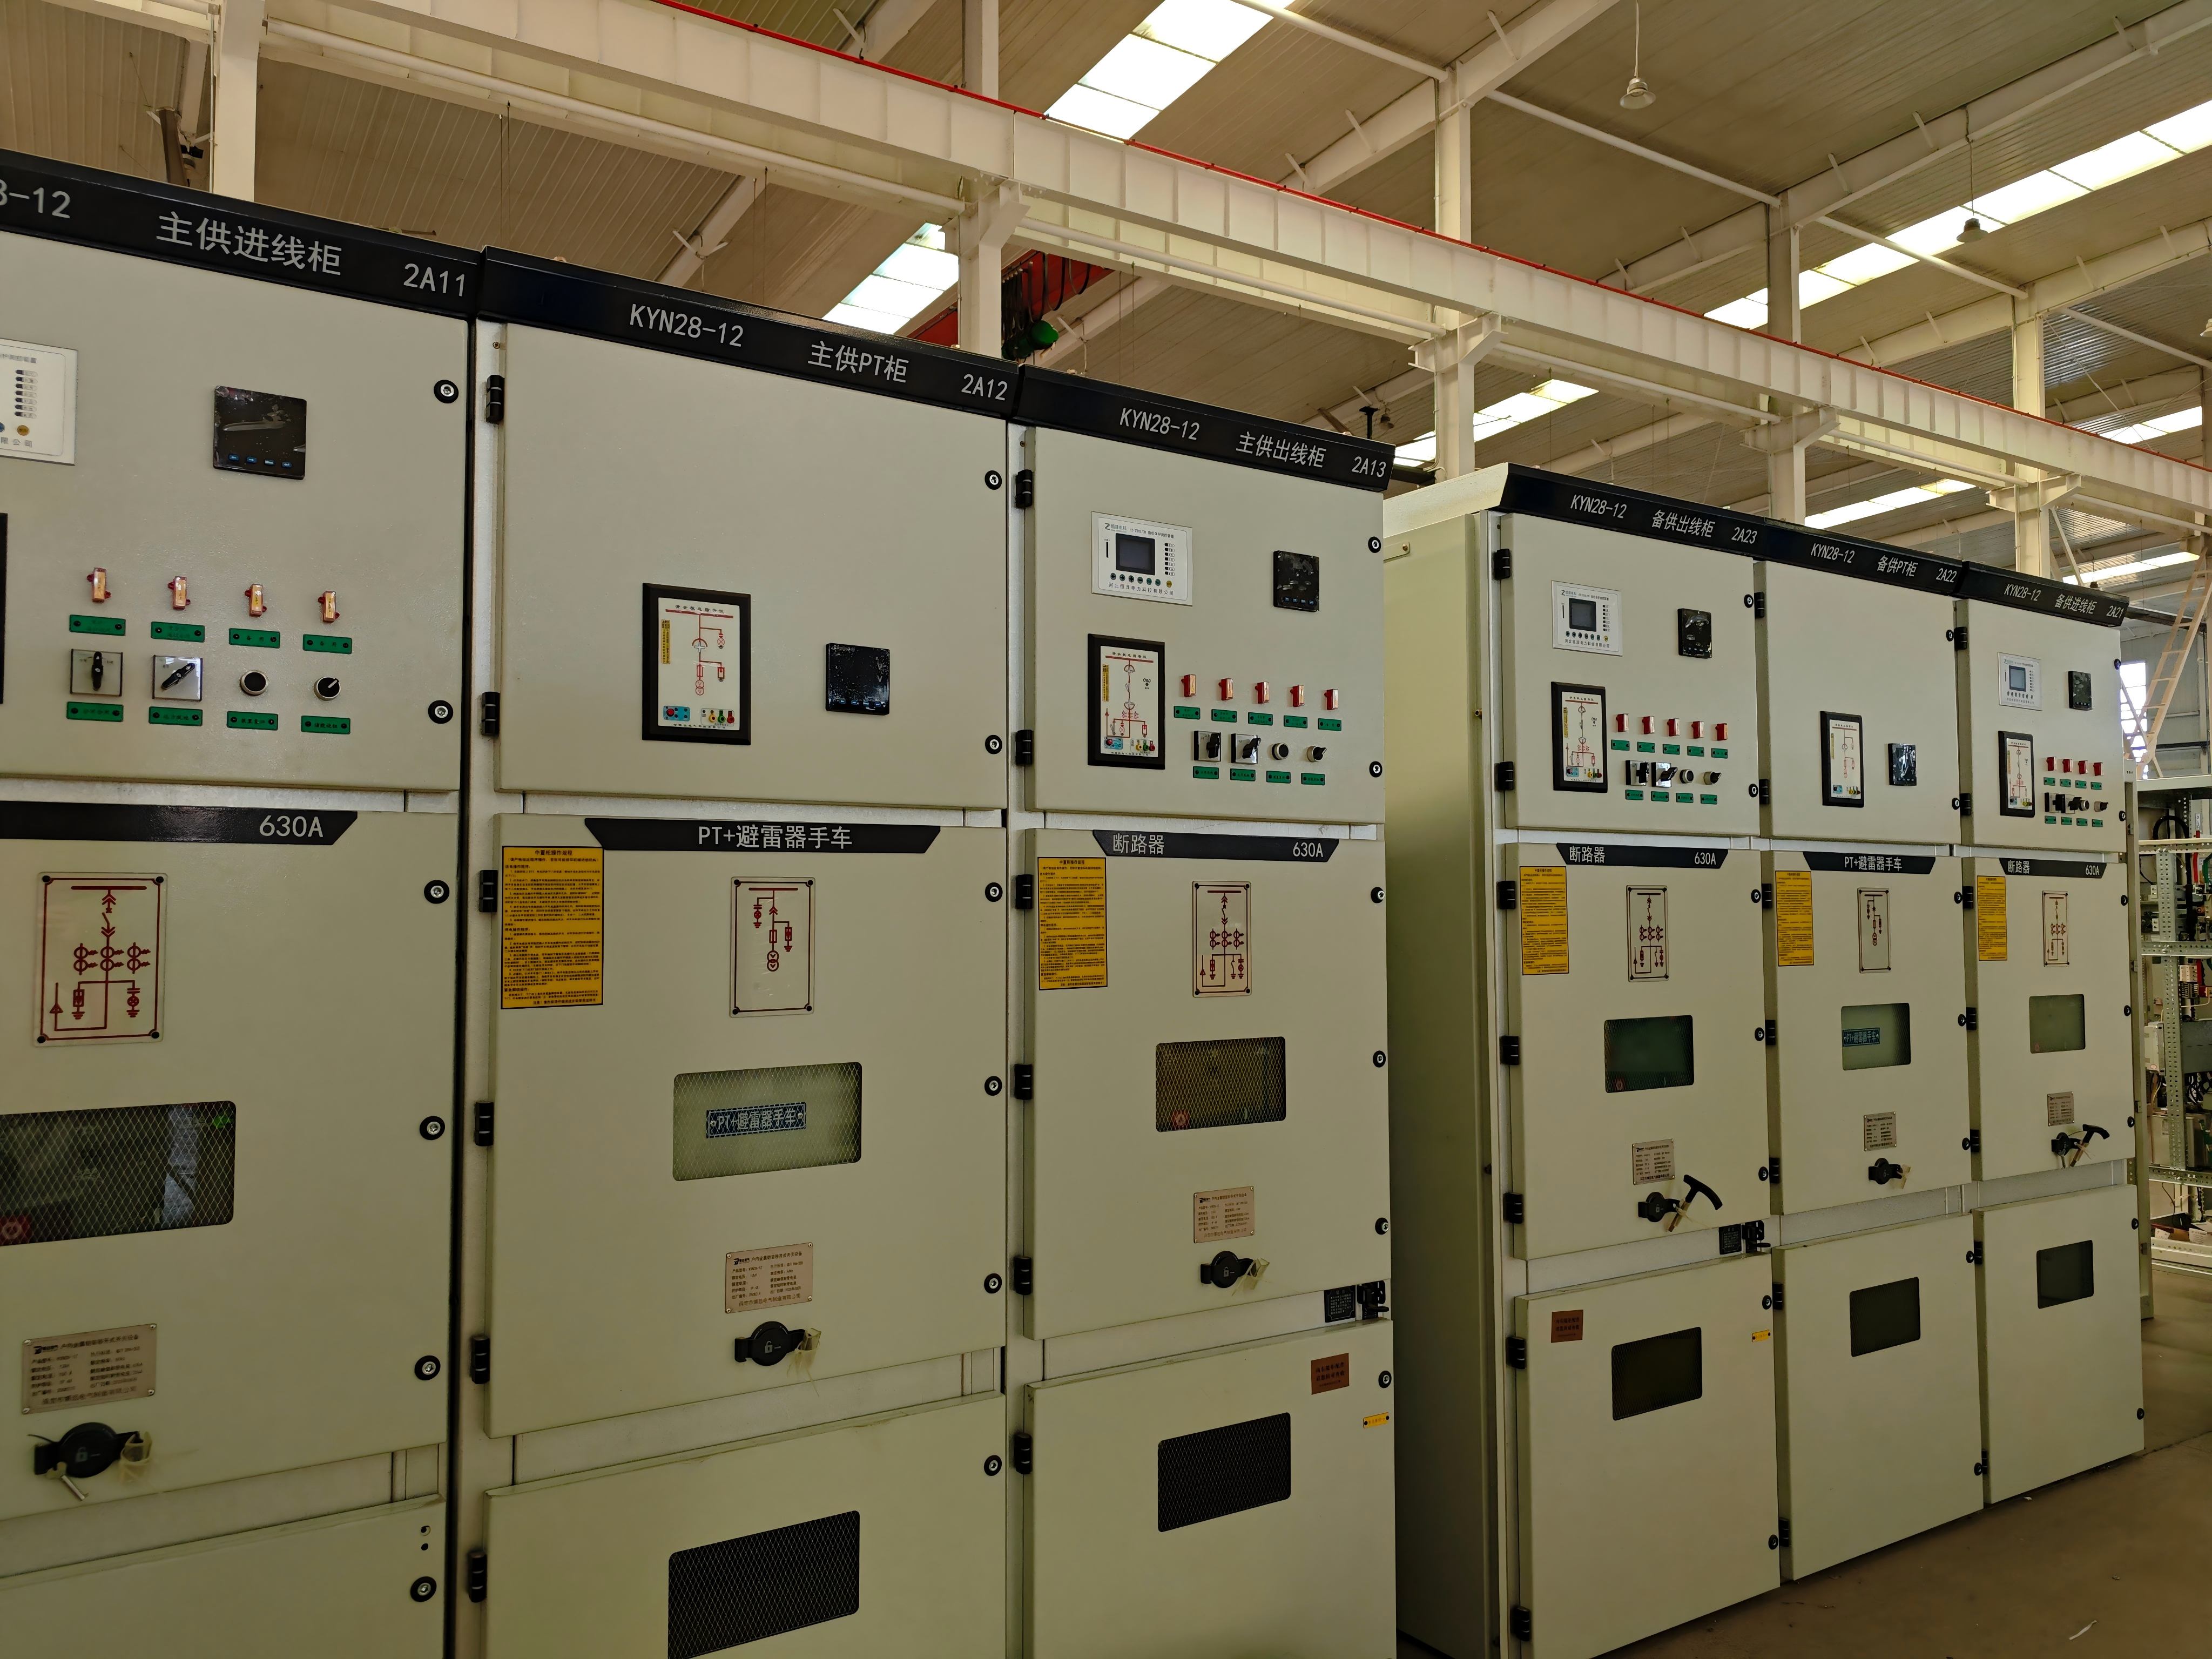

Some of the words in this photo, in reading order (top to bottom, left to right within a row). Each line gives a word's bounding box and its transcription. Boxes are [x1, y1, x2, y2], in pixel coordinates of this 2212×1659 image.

[157, 211, 342, 275] 主供进线柜
[404, 263, 465, 297] 2A11
[630, 302, 748, 347] KYN28-12
[807, 340, 909, 383] 主供PT柜
[961, 374, 1008, 401] 2A12
[1120, 407, 1200, 440] KYN28-12
[1236, 431, 1327, 468] 主供出线柜
[1351, 456, 1386, 477] 2A13
[1570, 494, 1627, 518] KYN28-12
[1651, 509, 1716, 537] 备供出线柜
[1731, 527, 1757, 544] 2A23
[1810, 543, 1855, 563] KYN28-12
[1877, 555, 1919, 577] 备供PT柜
[1936, 568, 1957, 583] 2A22
[2004, 583, 2041, 602] KYN28-12
[2054, 593, 2098, 615] 备供进线柜
[2106, 605, 2125, 619] 2A21
[259, 815, 323, 838] 630A
[699, 824, 852, 849] PT+避雷器手车
[1113, 834, 1164, 855] 断路器
[1293, 842, 1324, 858] 630A
[1569, 846, 1606, 864] 断路器
[1694, 852, 1716, 865] 630A
[1844, 856, 1902, 871] PT+避雷器手车
[2008, 860, 2030, 874] 断路器
[2085, 865, 2100, 875] 630A
[718, 1107, 796, 1130] PT+避雷器手车
